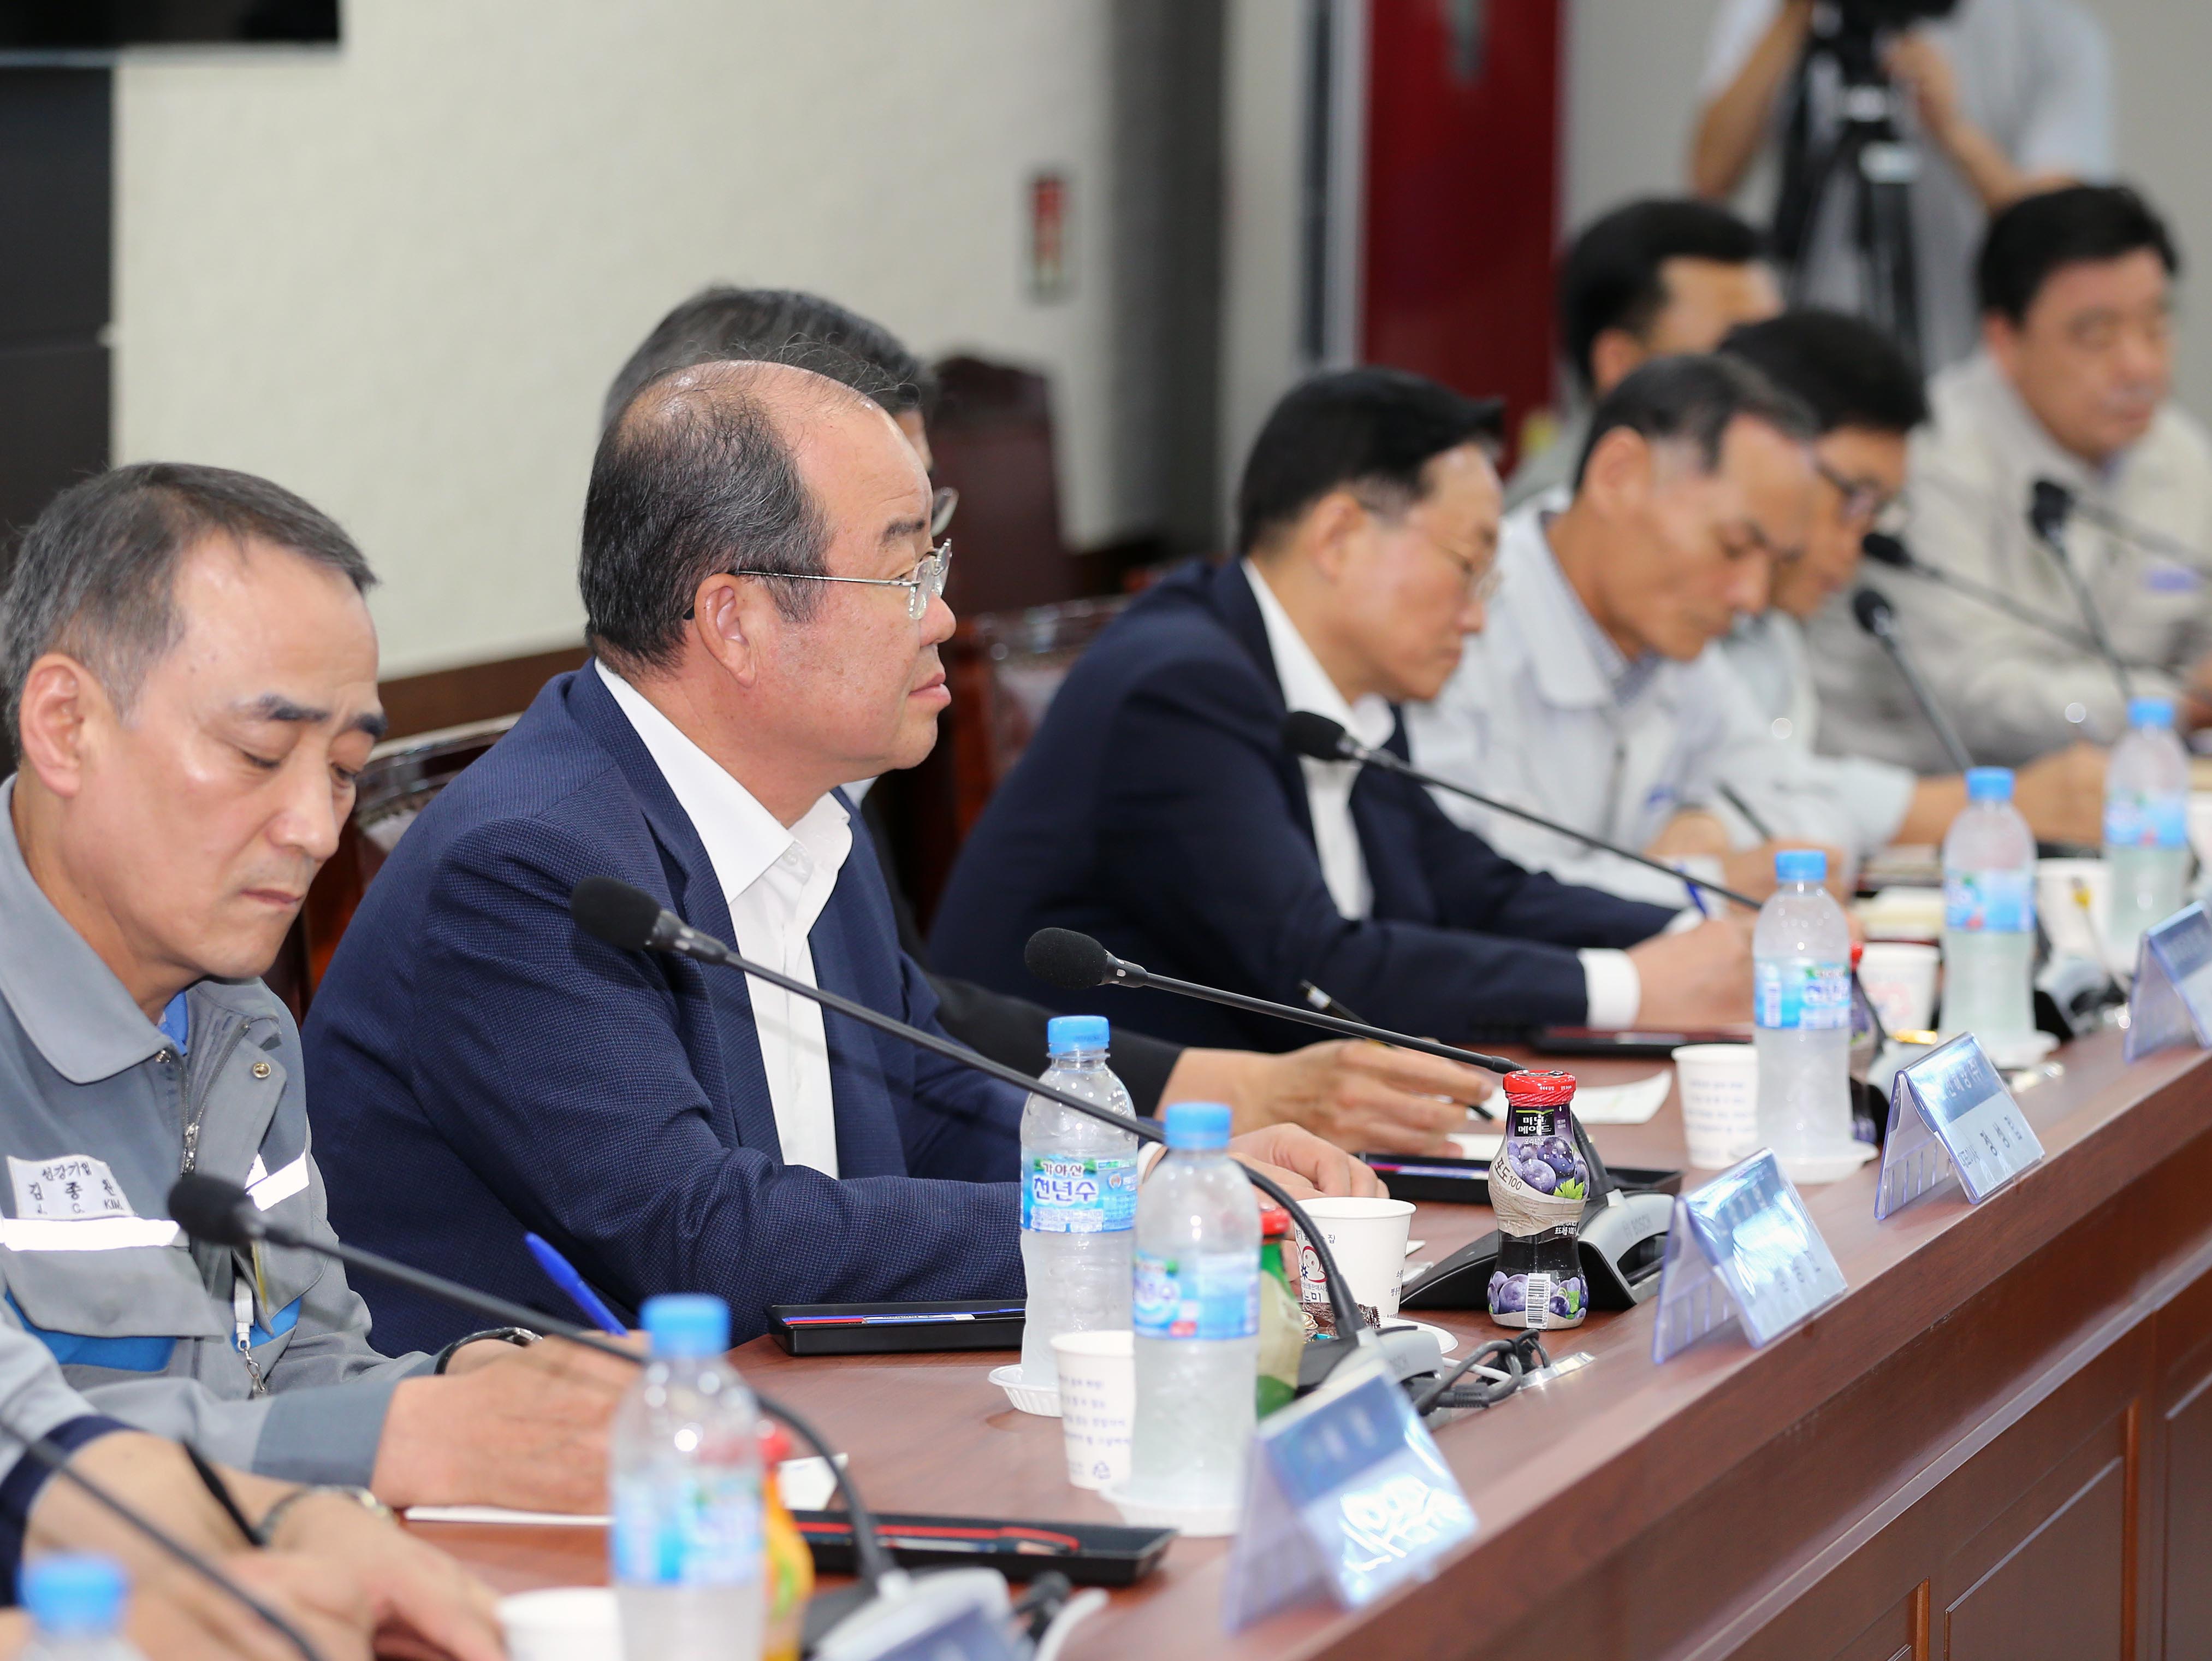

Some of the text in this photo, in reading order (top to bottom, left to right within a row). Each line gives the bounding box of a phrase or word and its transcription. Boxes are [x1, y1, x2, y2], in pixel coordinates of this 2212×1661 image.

[1042, 1163, 1083, 1177] 가야산
[29, 1182, 43, 1200] 김
[1034, 1177, 1098, 1202] 천년수
